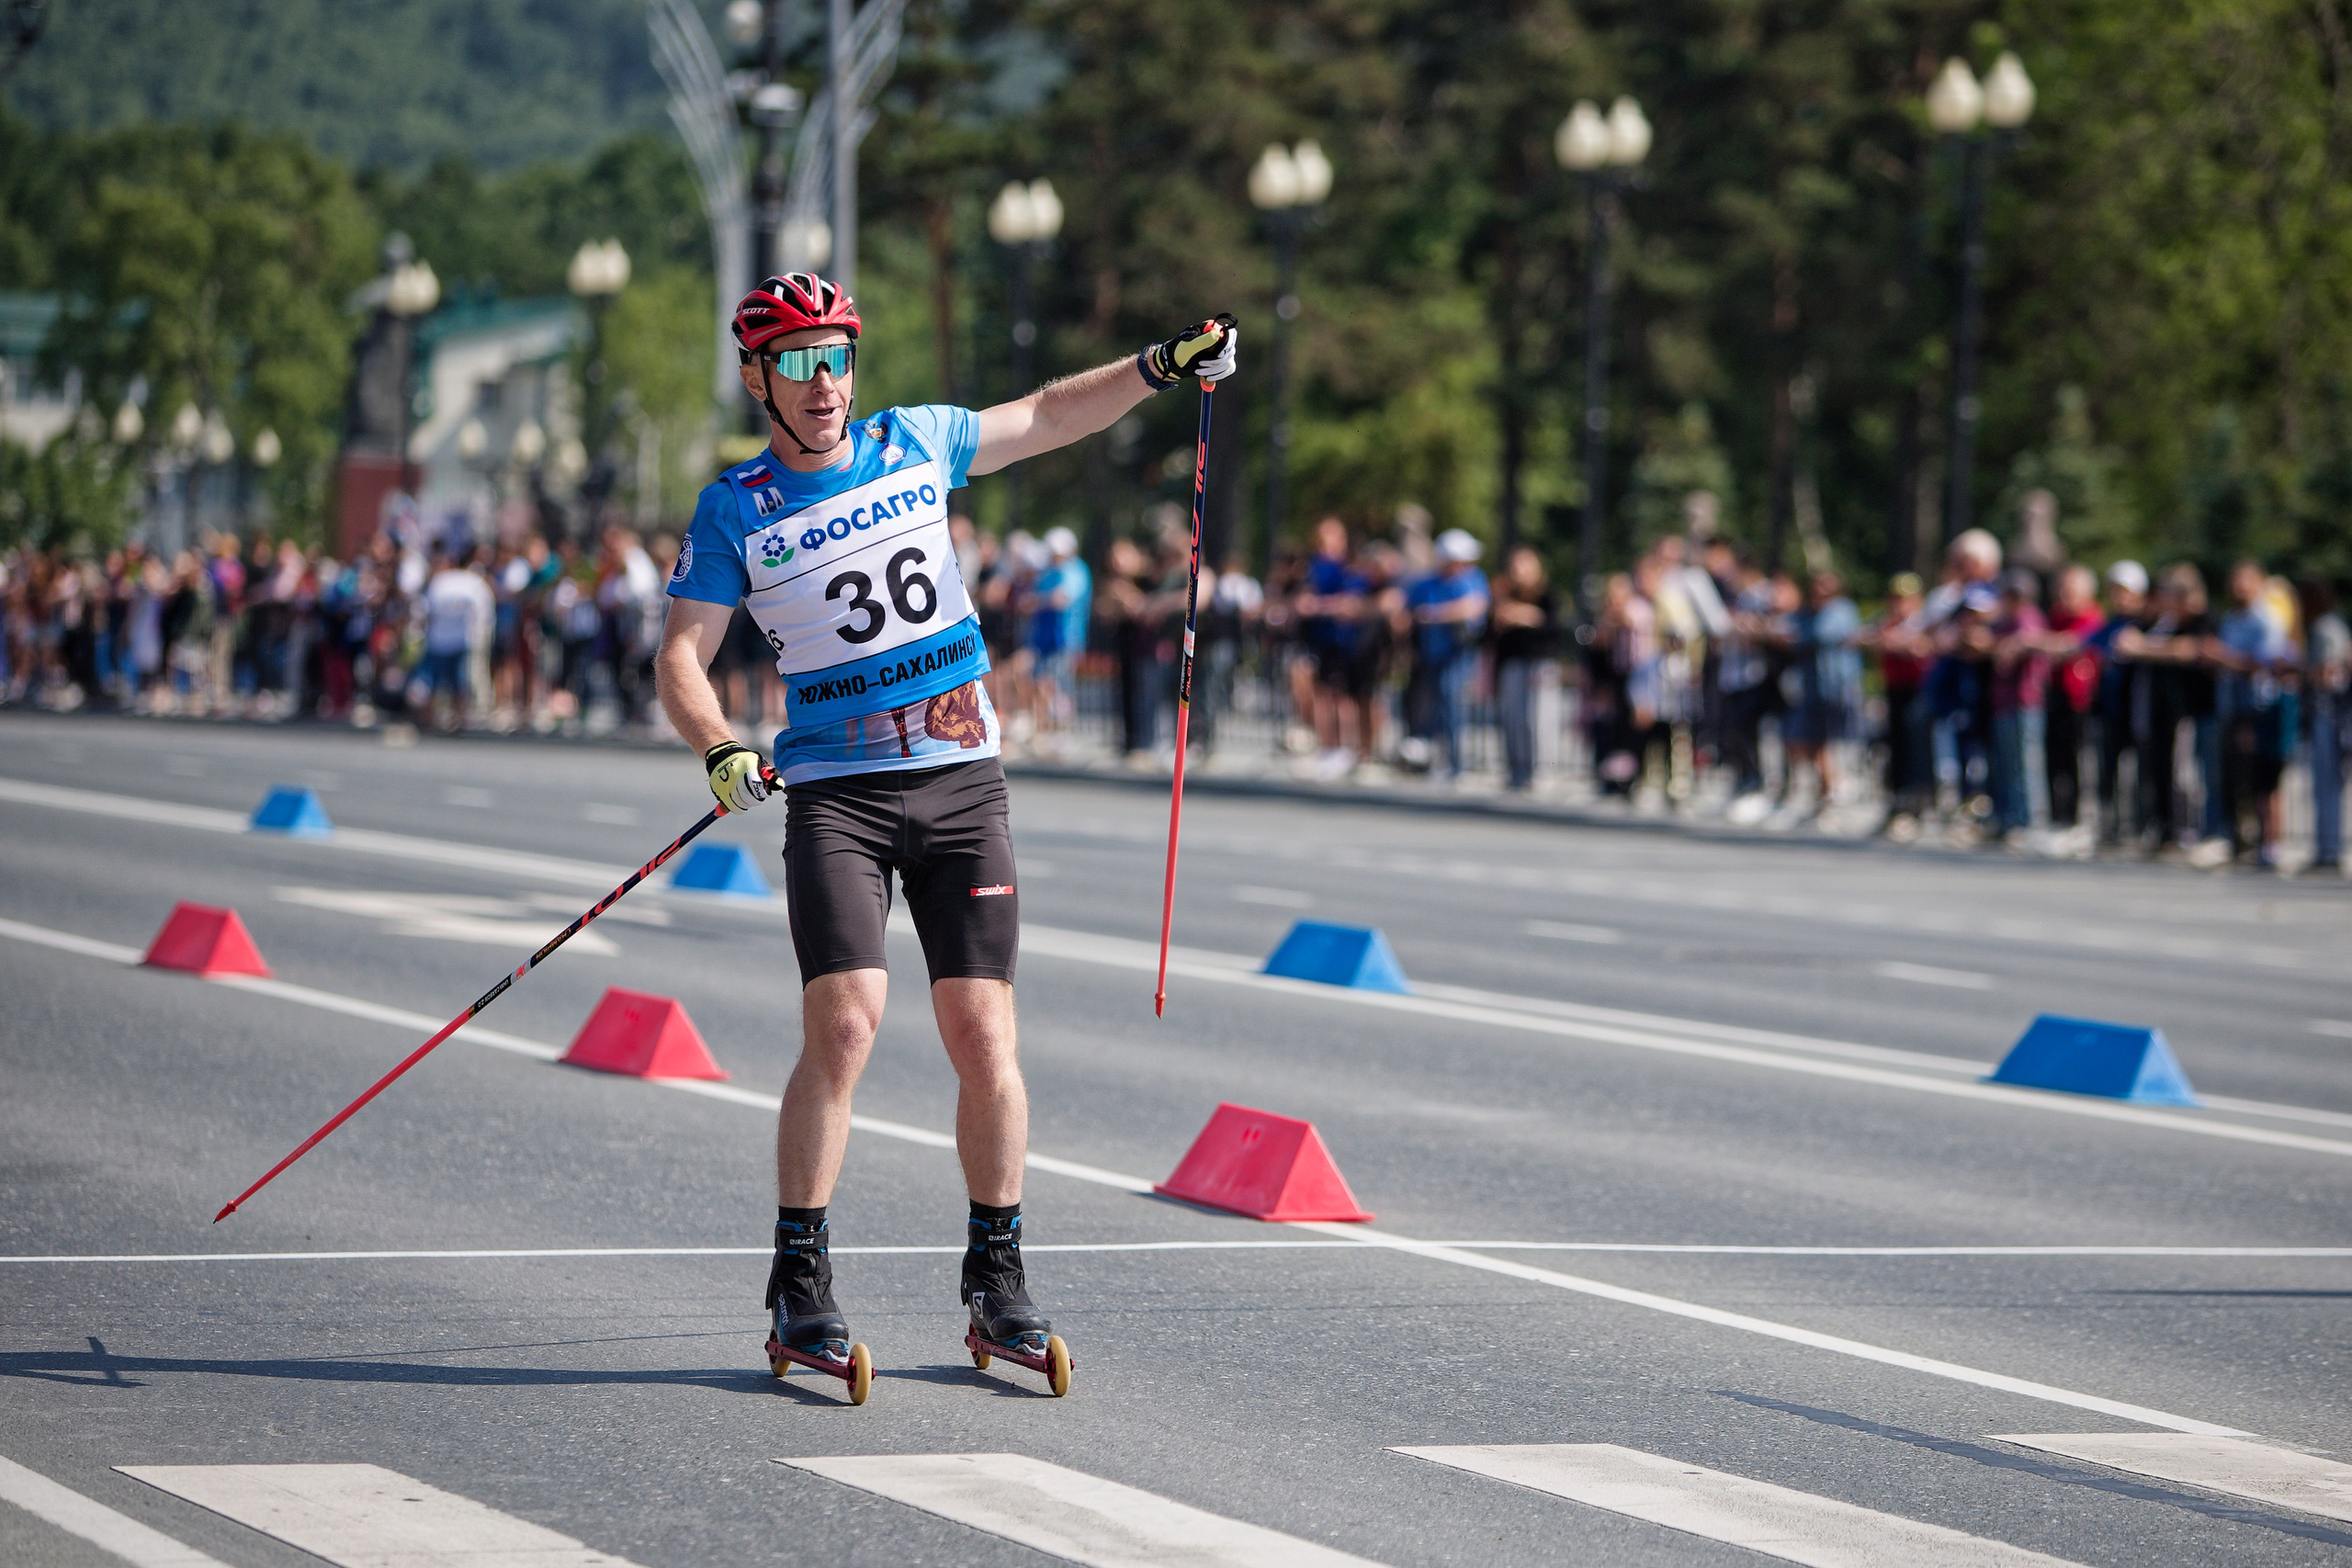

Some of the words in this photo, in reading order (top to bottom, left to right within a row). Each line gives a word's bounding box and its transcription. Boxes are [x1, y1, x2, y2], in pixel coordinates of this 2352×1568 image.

[741, 307, 770, 315] SCOTT
[799, 483, 937, 551] ФОСАГРО
[825, 547, 937, 645] 36
[575, 836, 683, 931] PILOT
